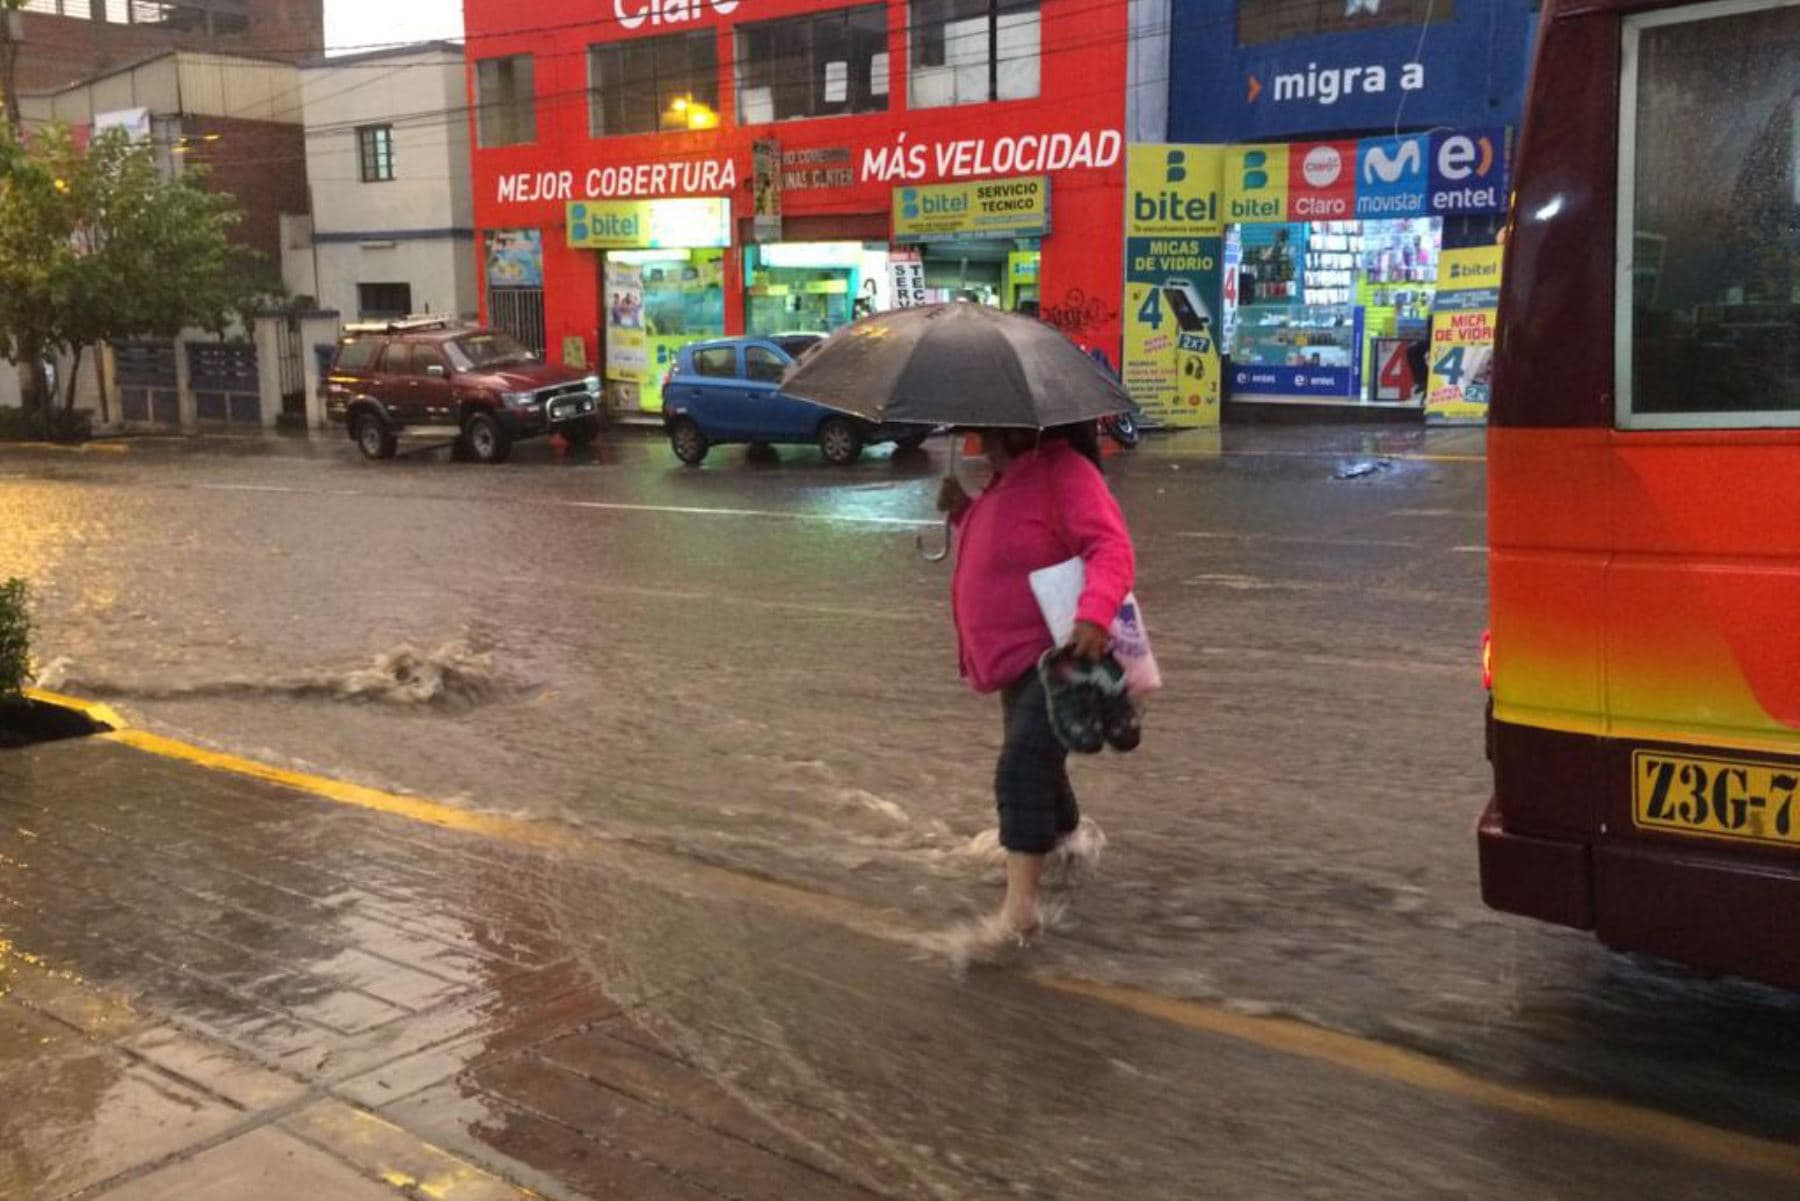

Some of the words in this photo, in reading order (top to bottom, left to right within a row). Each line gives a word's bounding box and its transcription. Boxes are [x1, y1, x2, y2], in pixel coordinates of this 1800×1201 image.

[1273, 62, 1386, 104] migra
[1401, 62, 1424, 90] a
[861, 132, 928, 182] MÁS
[934, 130, 1122, 178] VELOCIDAD
[497, 170, 573, 203] MEJOR
[585, 159, 737, 198] COBERTURA
[977, 183, 1038, 199] SERVICIO
[922, 193, 968, 214] bitel
[1134, 191, 1217, 221] bitel
[1231, 199, 1279, 217] bitel
[1295, 197, 1346, 215] Claro
[1357, 193, 1424, 213] movistar
[1432, 186, 1497, 209] entel
[591, 213, 638, 236] bitel
[1149, 241, 1200, 256] MICAS
[1135, 256, 1155, 271] DE
[1160, 256, 1213, 271] VIDRIO
[1462, 261, 1496, 276] bitel
[1137, 287, 1163, 330] 4
[1435, 329, 1454, 342] DE
[1381, 338, 1415, 400] 4
[1433, 347, 1465, 386] 4
[1647, 760, 1799, 836] Z3G-7
